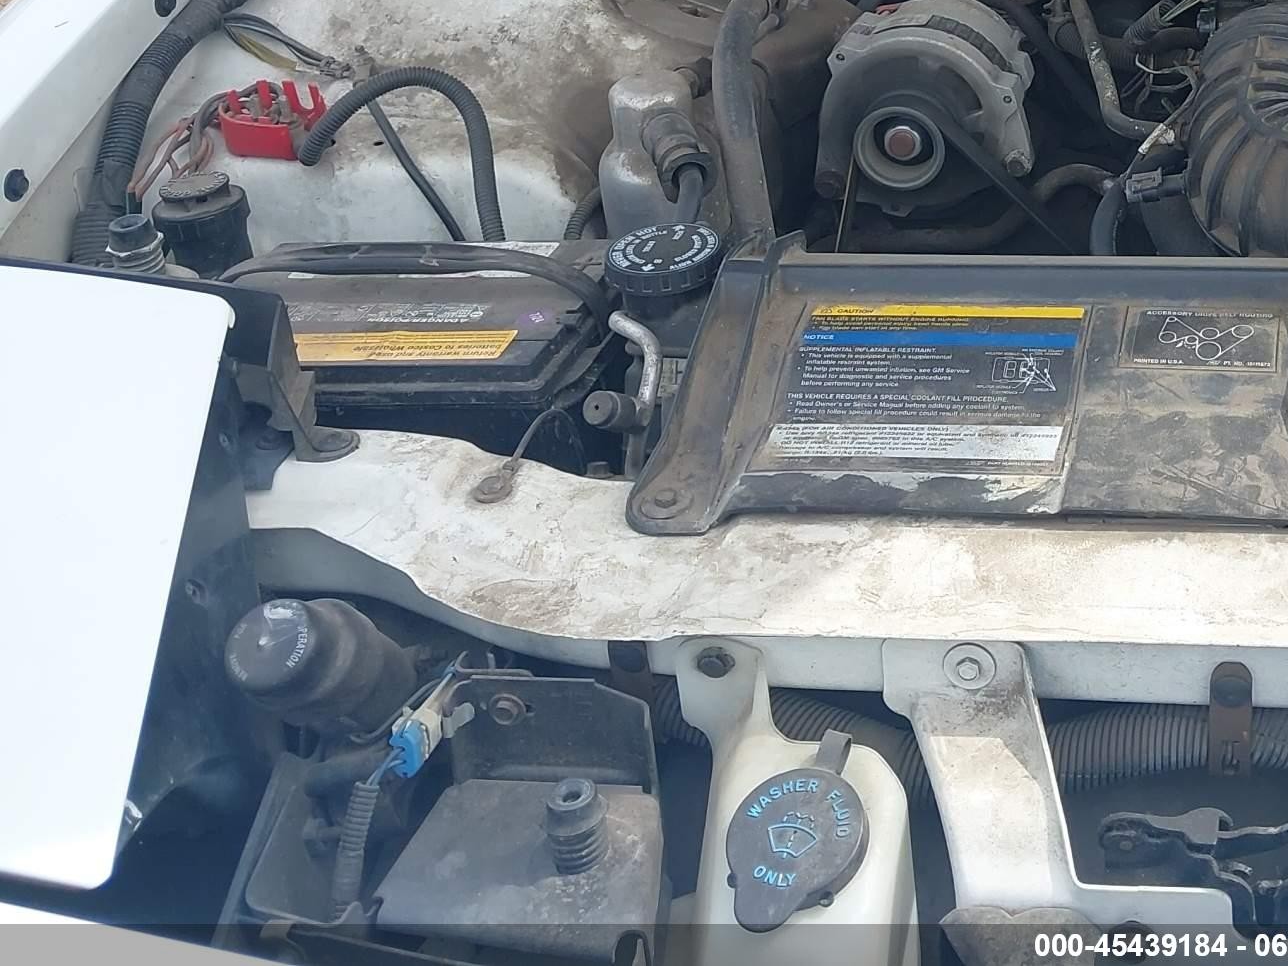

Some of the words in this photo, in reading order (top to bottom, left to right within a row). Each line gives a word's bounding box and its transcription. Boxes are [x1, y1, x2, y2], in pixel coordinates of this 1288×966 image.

[635, 226, 658, 236] HOT
[394, 350, 414, 358] and
[416, 350, 460, 358] warranty
[462, 350, 497, 358] Return
[804, 392, 835, 400] VEHICLE
[746, 779, 818, 819] WASHER
[825, 790, 851, 840] FLUID
[752, 865, 796, 888] ONLY
